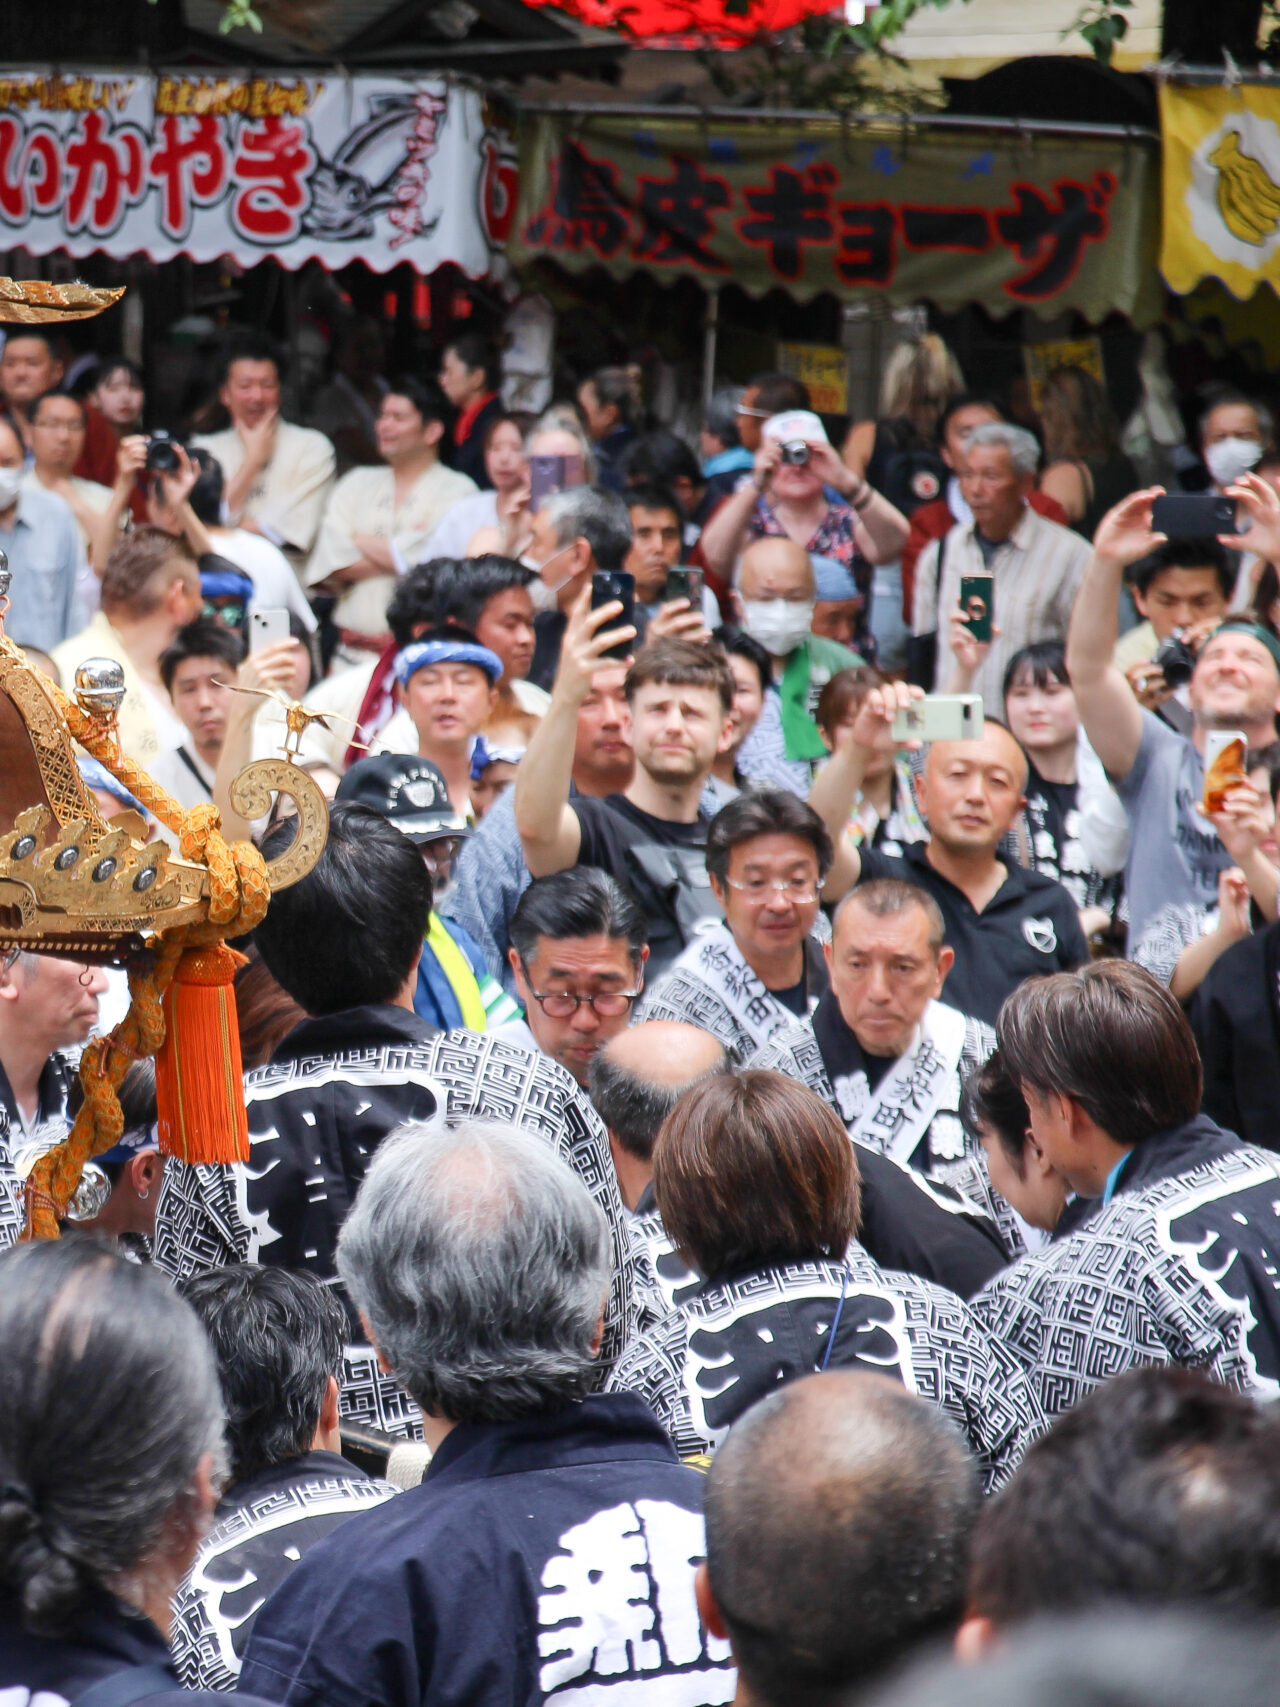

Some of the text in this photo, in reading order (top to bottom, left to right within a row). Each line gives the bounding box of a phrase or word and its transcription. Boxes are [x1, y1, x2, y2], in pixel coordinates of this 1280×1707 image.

[524, 137, 1118, 299] 鳥皮ギョーザ
